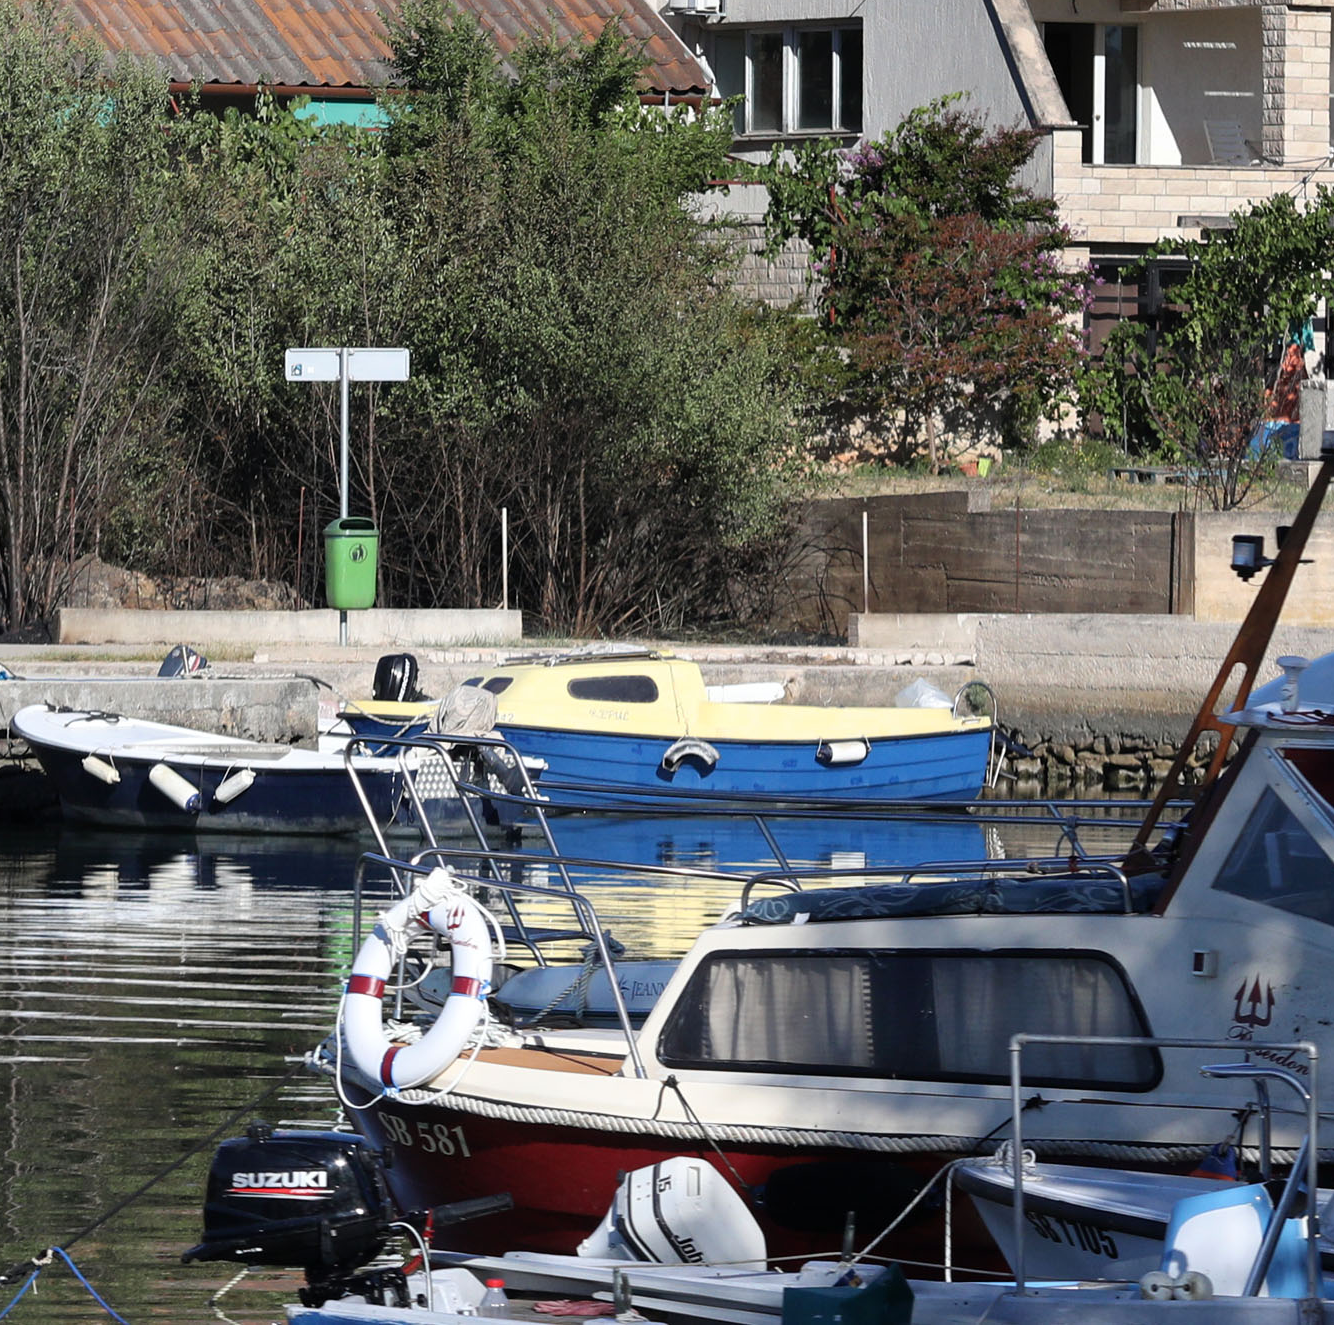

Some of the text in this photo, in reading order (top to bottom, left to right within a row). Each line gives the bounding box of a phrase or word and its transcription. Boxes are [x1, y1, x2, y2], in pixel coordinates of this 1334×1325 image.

[1225, 1025, 1309, 1075] Pseidon
[378, 1111, 471, 1158] SB 581
[232, 1170, 328, 1188] SUZUKI
[657, 1174, 673, 1194] 15
[674, 1234, 706, 1264] Joh
